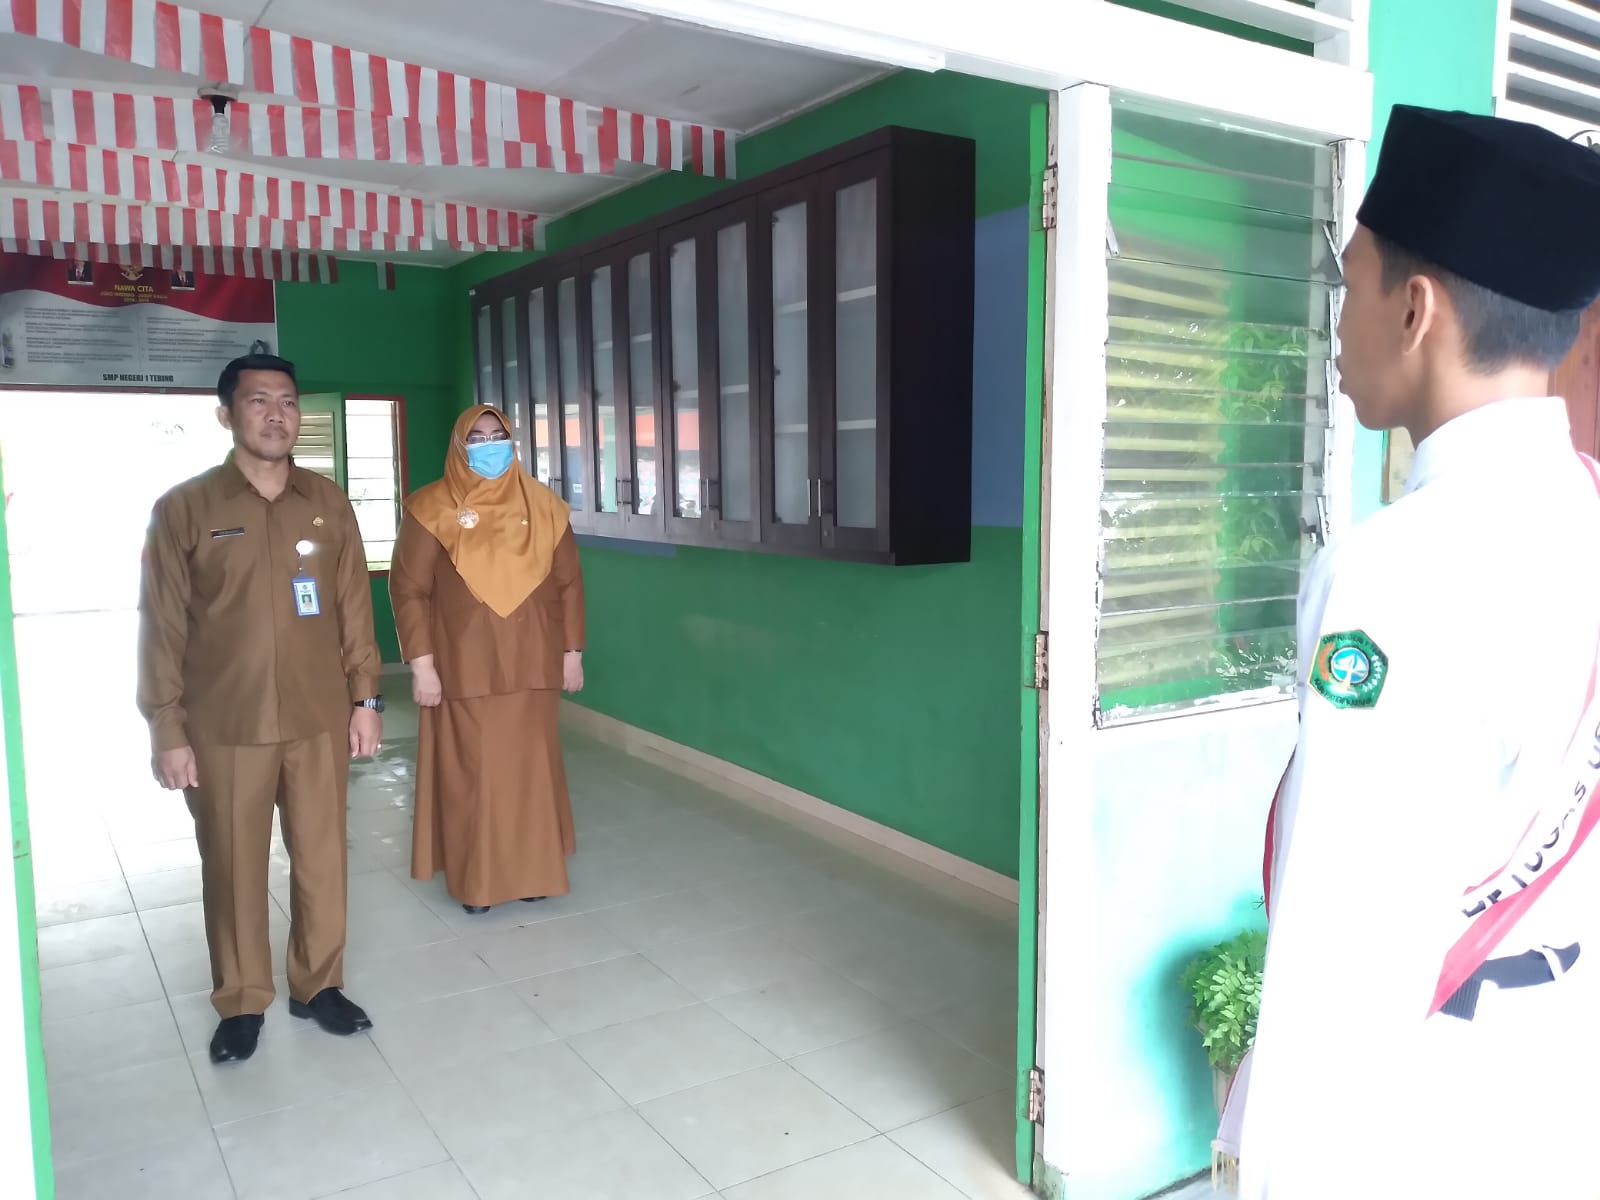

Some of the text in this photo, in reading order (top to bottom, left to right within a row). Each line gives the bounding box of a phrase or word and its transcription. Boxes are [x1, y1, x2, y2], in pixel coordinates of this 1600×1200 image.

[114, 284, 154, 293] NAWA CITA
[102, 373, 119, 381] SMP
[120, 374, 144, 382] NEGERI
[149, 374, 174, 383] TEBING
